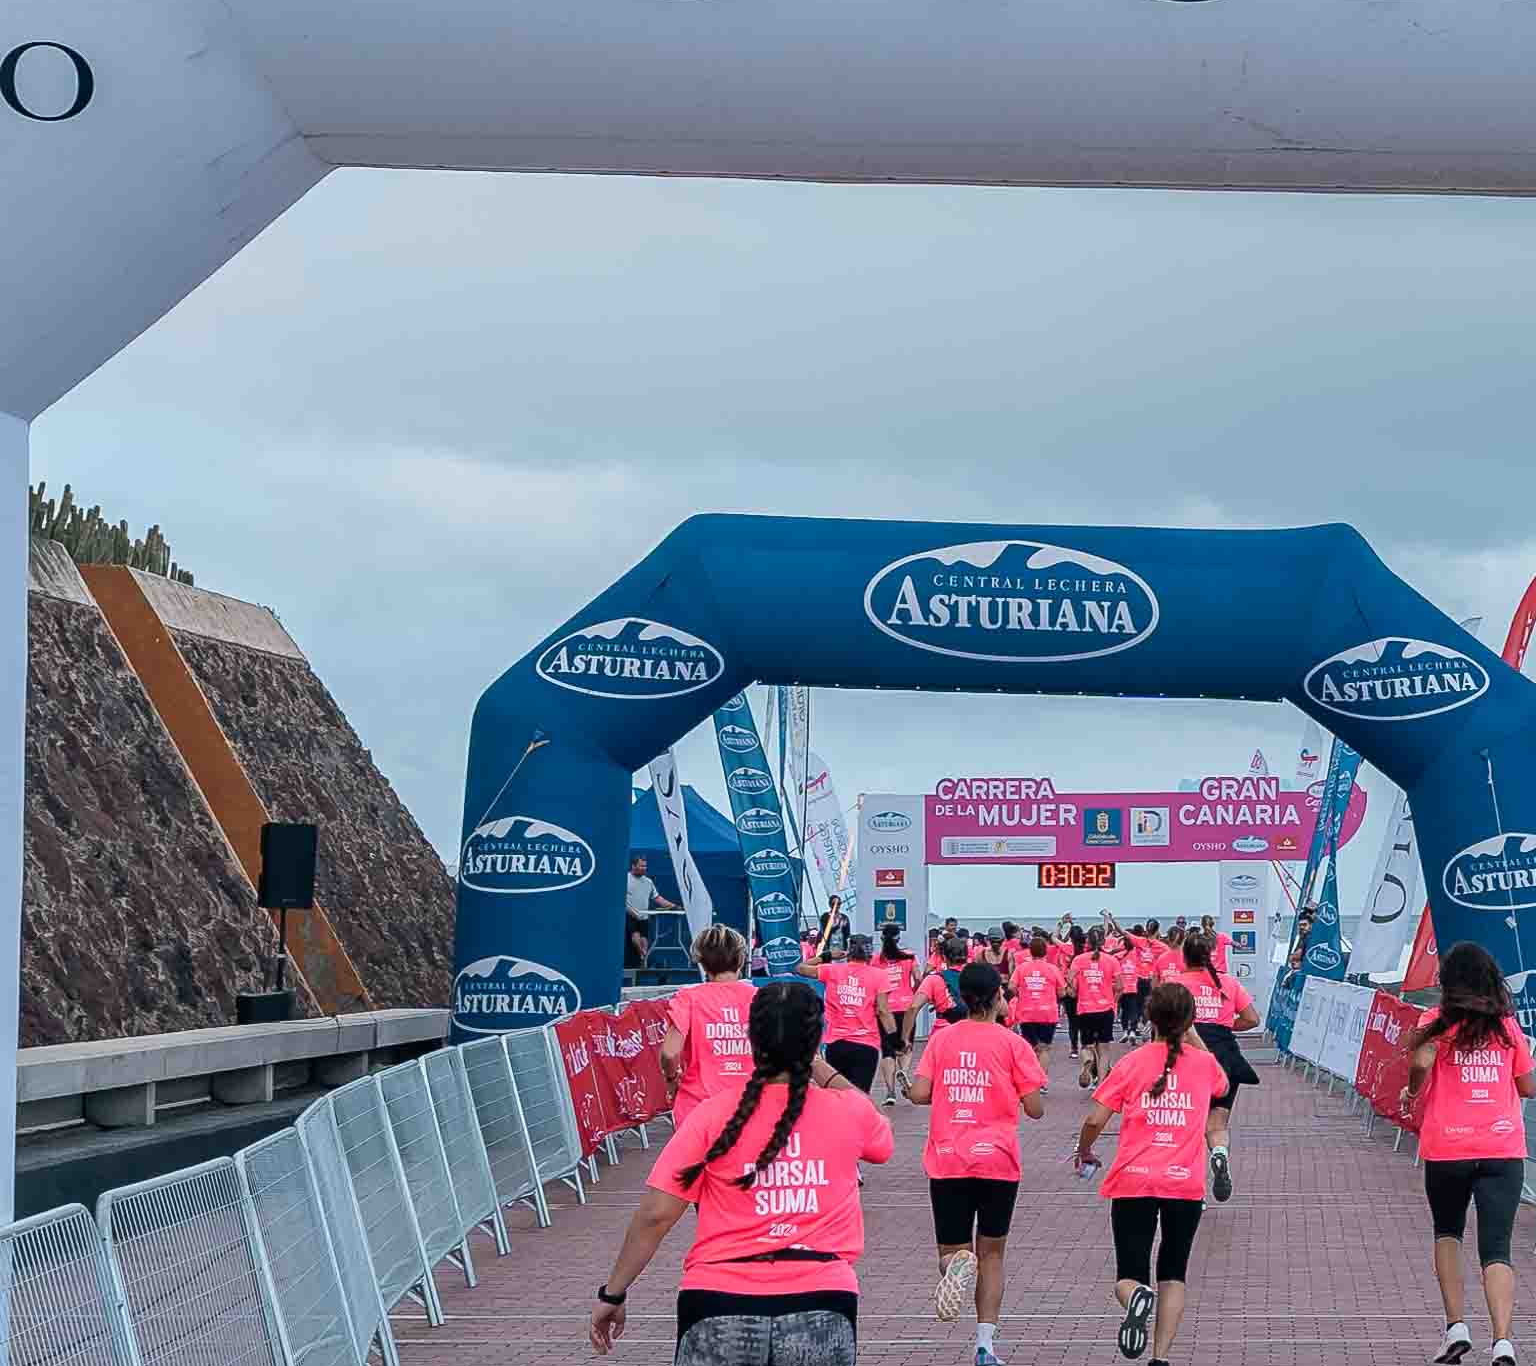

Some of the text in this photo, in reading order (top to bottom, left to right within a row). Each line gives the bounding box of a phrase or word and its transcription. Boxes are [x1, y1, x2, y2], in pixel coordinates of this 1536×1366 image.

[932, 573, 1128, 594] CENTRAL LECHERA
[578, 642, 705, 659] CENTRAL LECHERA
[1342, 660, 1469, 679] CENTRAL LECHERA
[937, 780, 1055, 801] CARRERA
[1201, 779, 1278, 801] GRAN
[935, 803, 1078, 827] DE LA MUJER
[1178, 804, 1301, 826] CANARIA
[870, 844, 910, 854] OYSHO
[721, 1007, 739, 1023] TU
[712, 1039, 752, 1056] SUMA
[959, 1051, 976, 1068] TU
[943, 1069, 992, 1087] DORSAL
[1461, 1067, 1500, 1084] SUMA
[947, 1086, 984, 1103] SUMA
[1146, 1109, 1187, 1126] SUMA
[754, 1188, 819, 1216] SUMA
